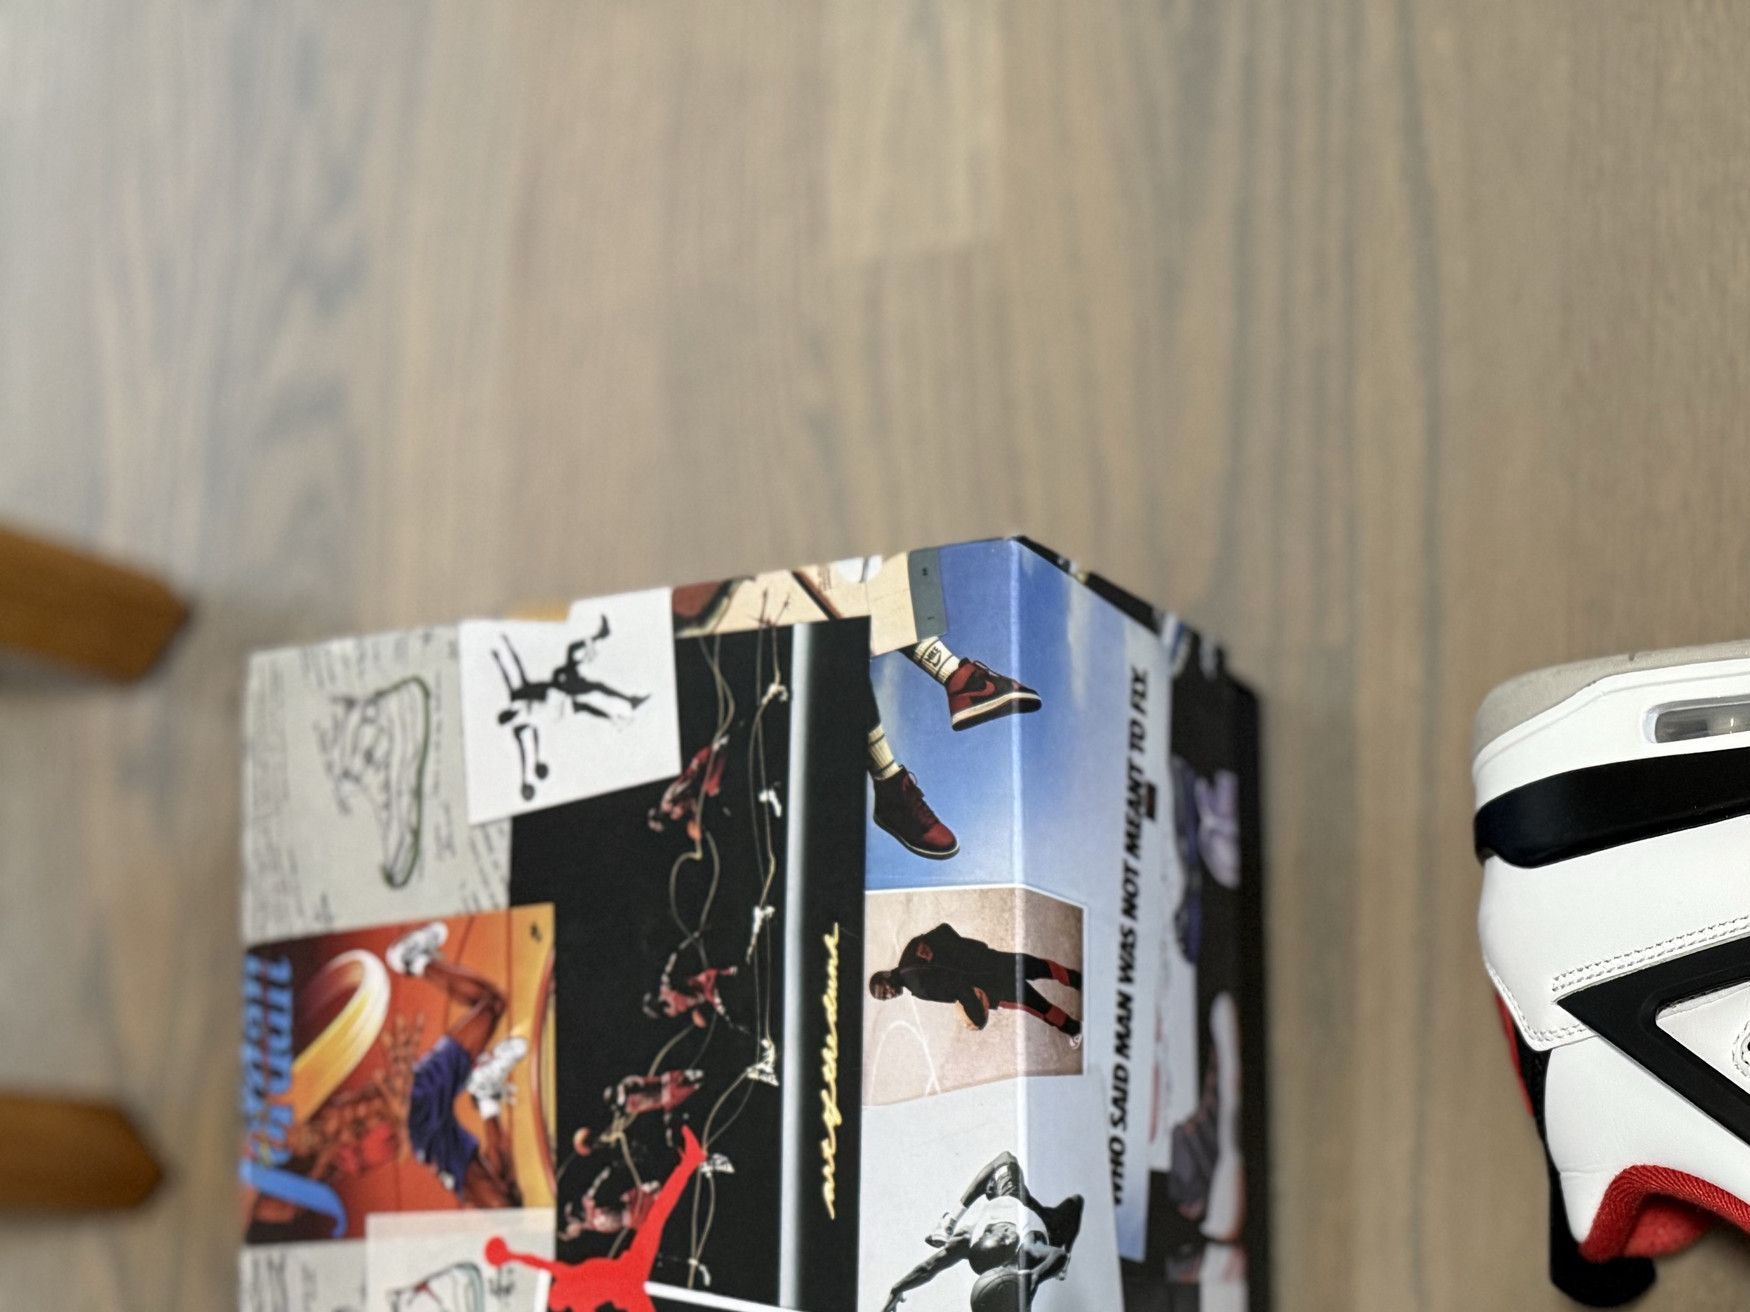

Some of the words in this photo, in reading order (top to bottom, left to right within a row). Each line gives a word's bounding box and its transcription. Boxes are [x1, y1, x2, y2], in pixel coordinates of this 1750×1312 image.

[1128, 718, 1144, 754] TO
[1123, 757, 1143, 859] MEANT
[1120, 862, 1139, 921] NOT
[1117, 923, 1138, 985] WAS
[1114, 992, 1134, 1060] MAN
[1110, 1064, 1130, 1132] SAID
